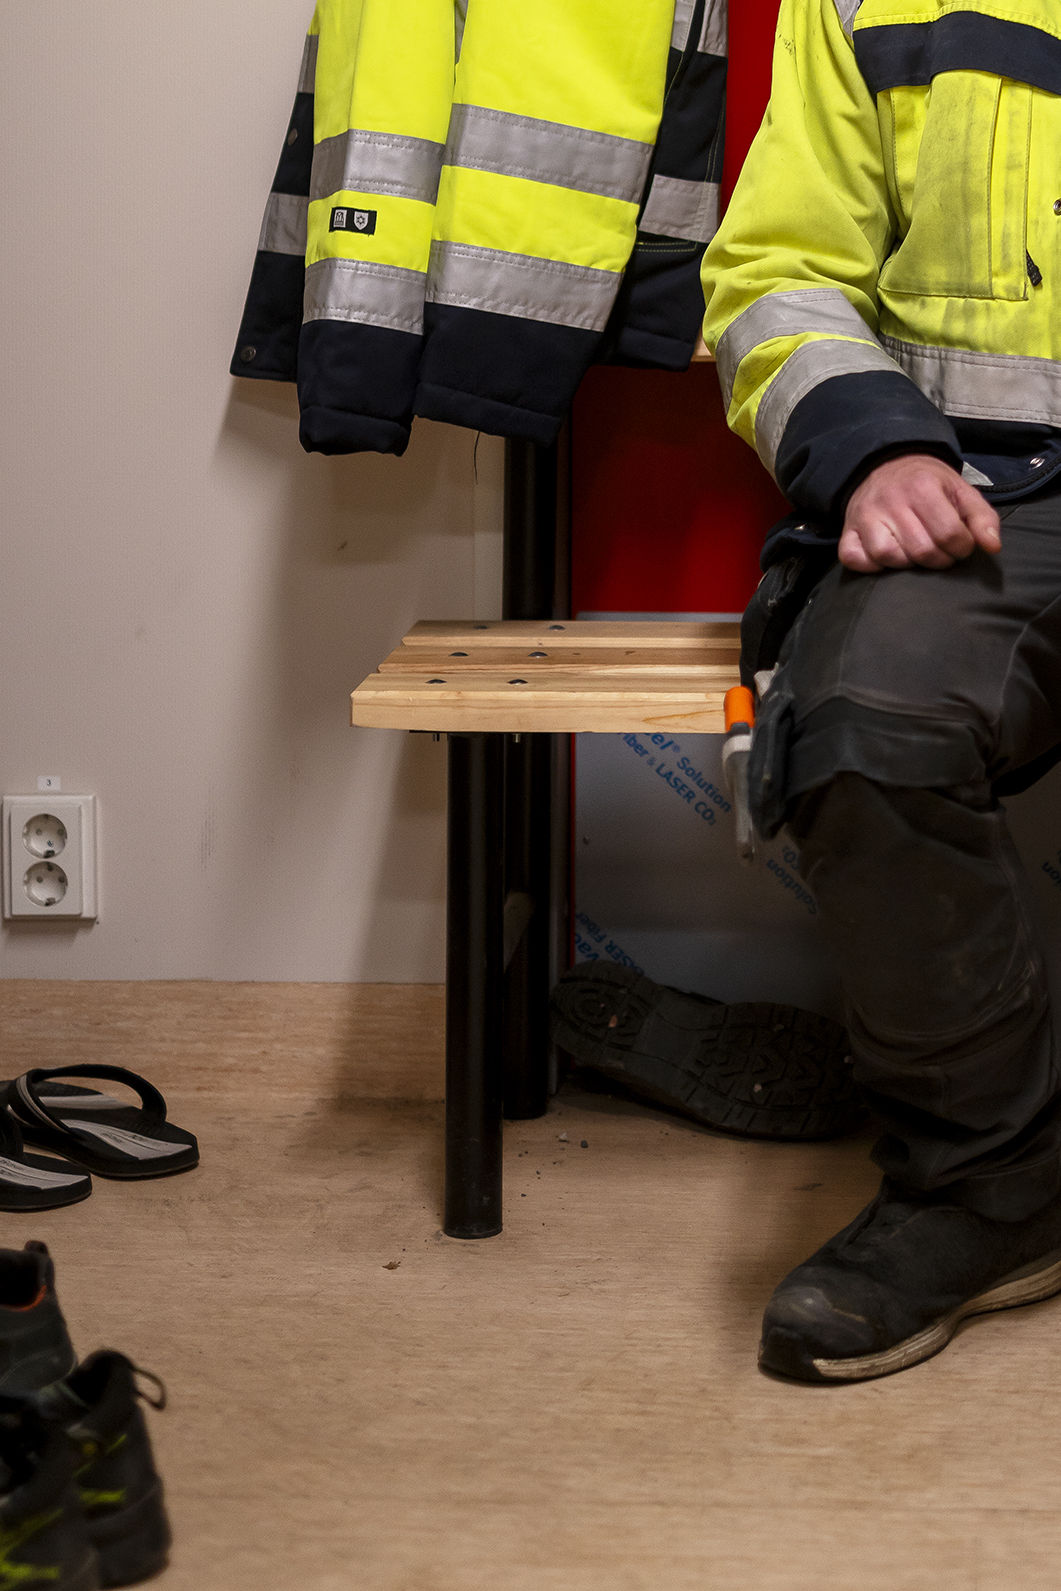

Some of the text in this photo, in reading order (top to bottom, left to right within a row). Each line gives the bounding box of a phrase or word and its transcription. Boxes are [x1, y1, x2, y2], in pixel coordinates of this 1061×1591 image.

[655, 763, 698, 804] LASER
[676, 757, 732, 814] Solution
[766, 858, 819, 916] Solution
[605, 938, 645, 977] SER
